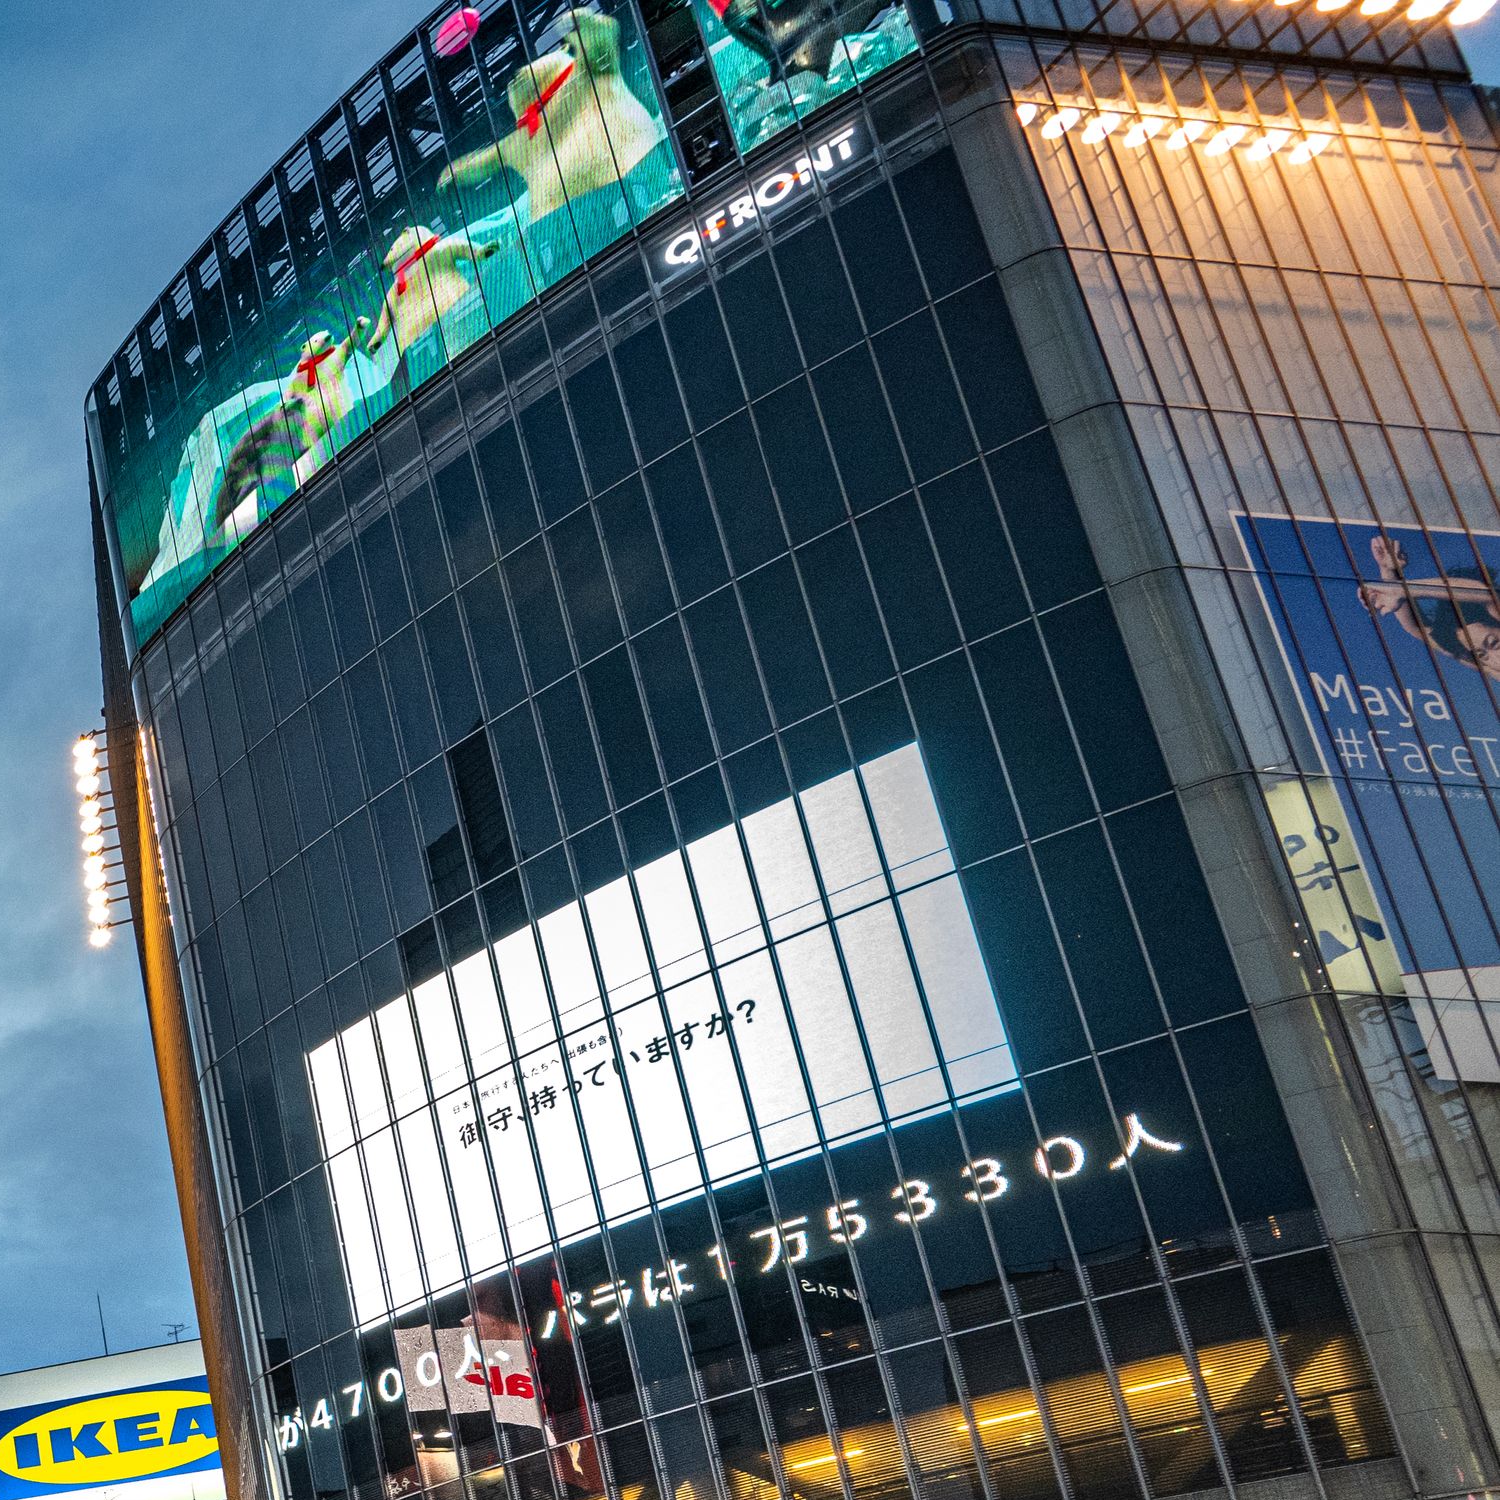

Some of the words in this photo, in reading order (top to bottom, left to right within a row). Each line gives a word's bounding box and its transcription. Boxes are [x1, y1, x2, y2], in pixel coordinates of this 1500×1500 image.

[664, 126, 855, 267] QFRONT
[1310, 672, 1452, 728] Maya
[13, 1404, 219, 1469] IKEA
